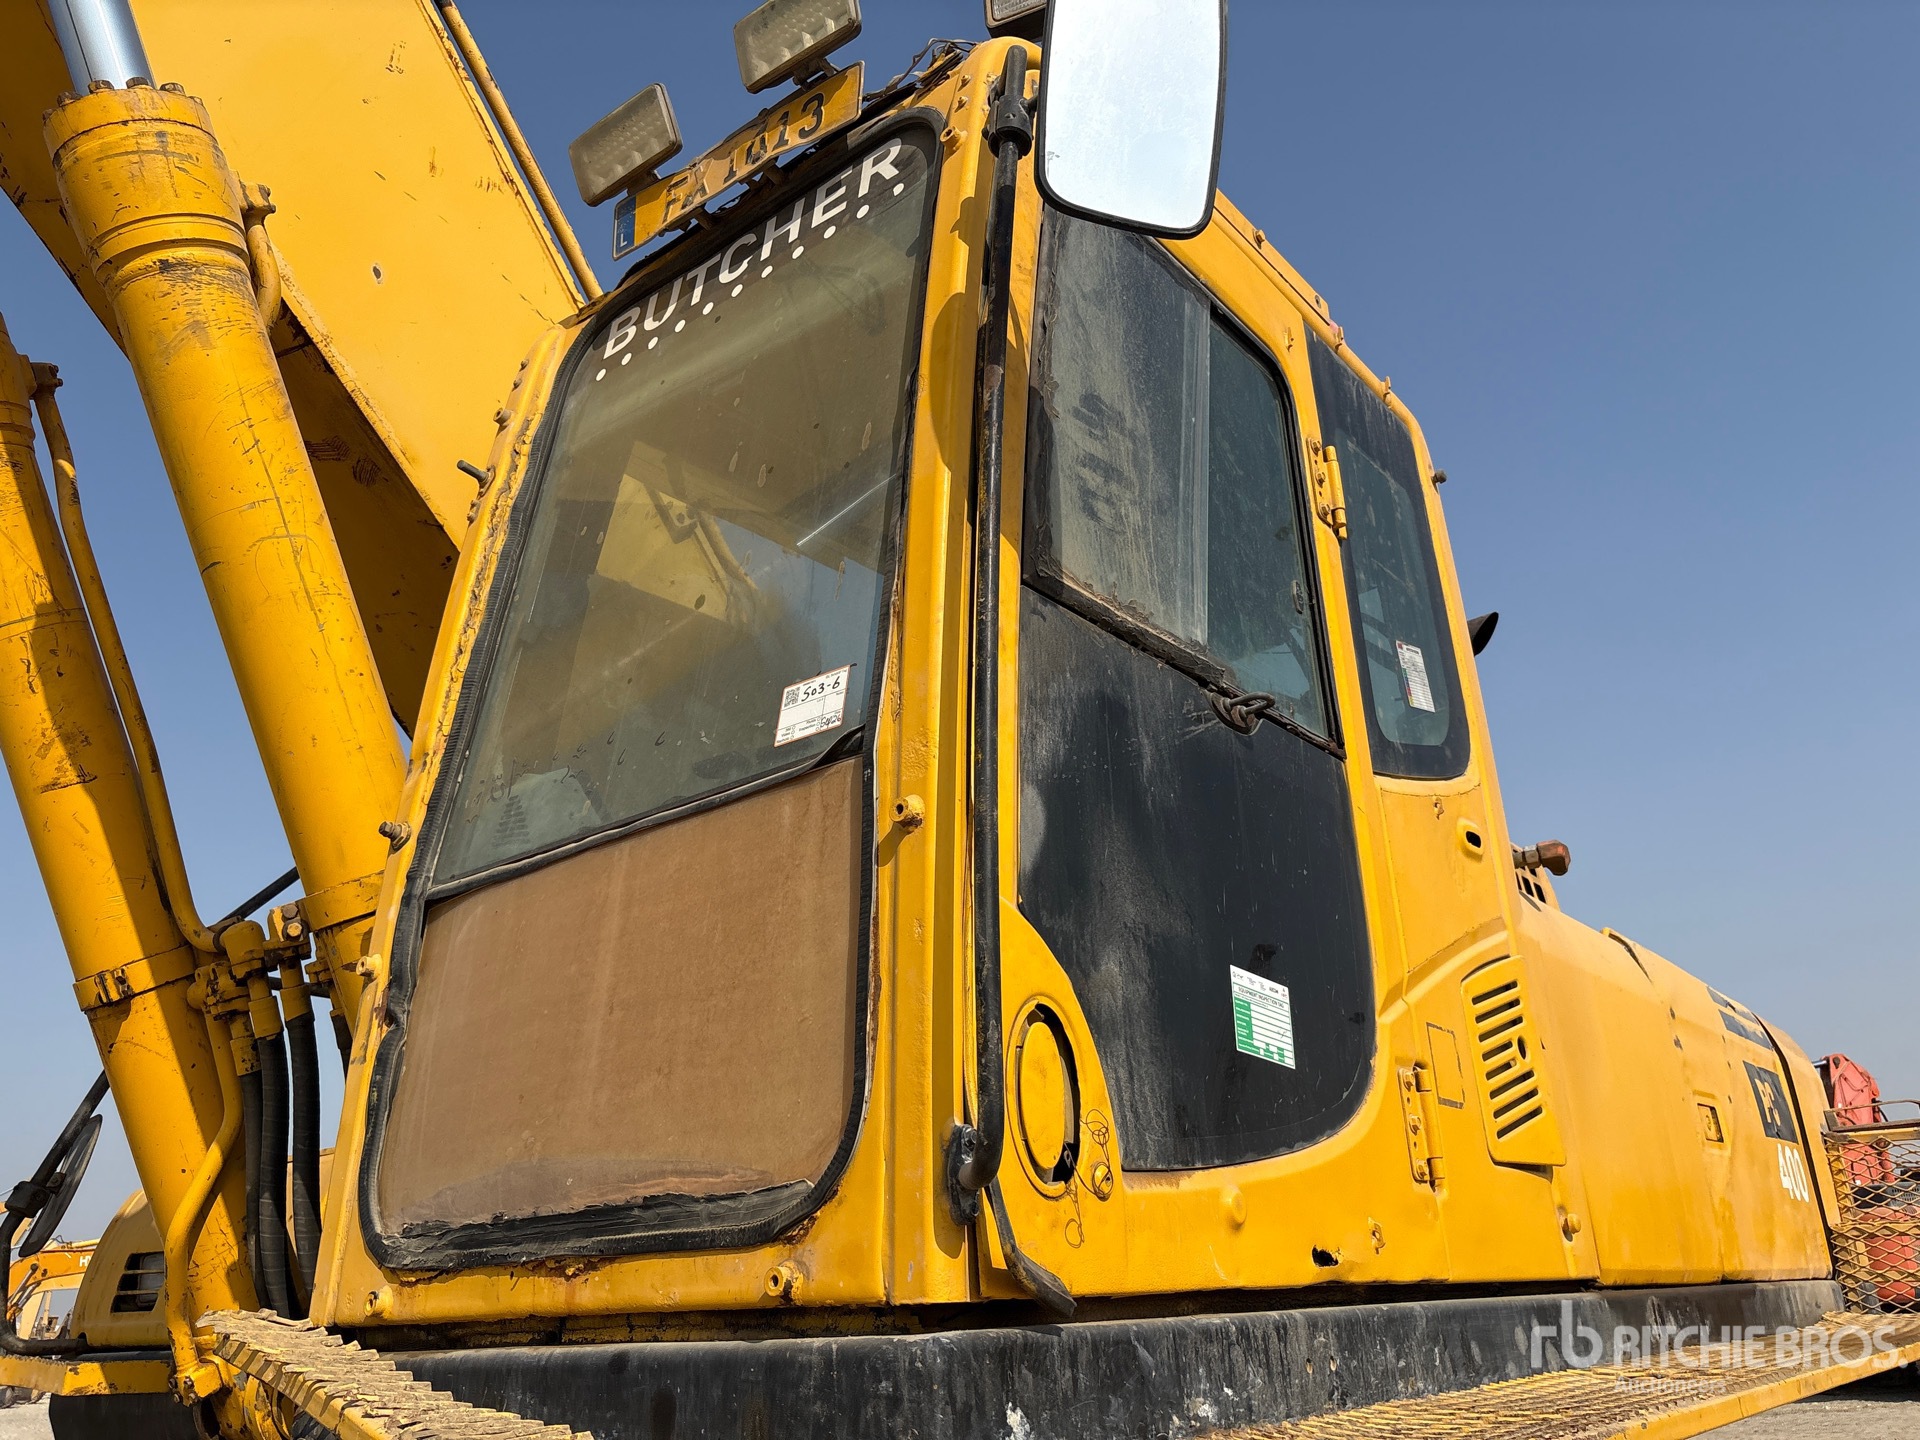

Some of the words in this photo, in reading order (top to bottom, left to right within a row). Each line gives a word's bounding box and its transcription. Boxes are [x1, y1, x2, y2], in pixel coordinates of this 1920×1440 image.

[602, 137, 902, 360] BUTCHER
[619, 233, 629, 247] L
[1777, 1142, 1809, 1203] 400
